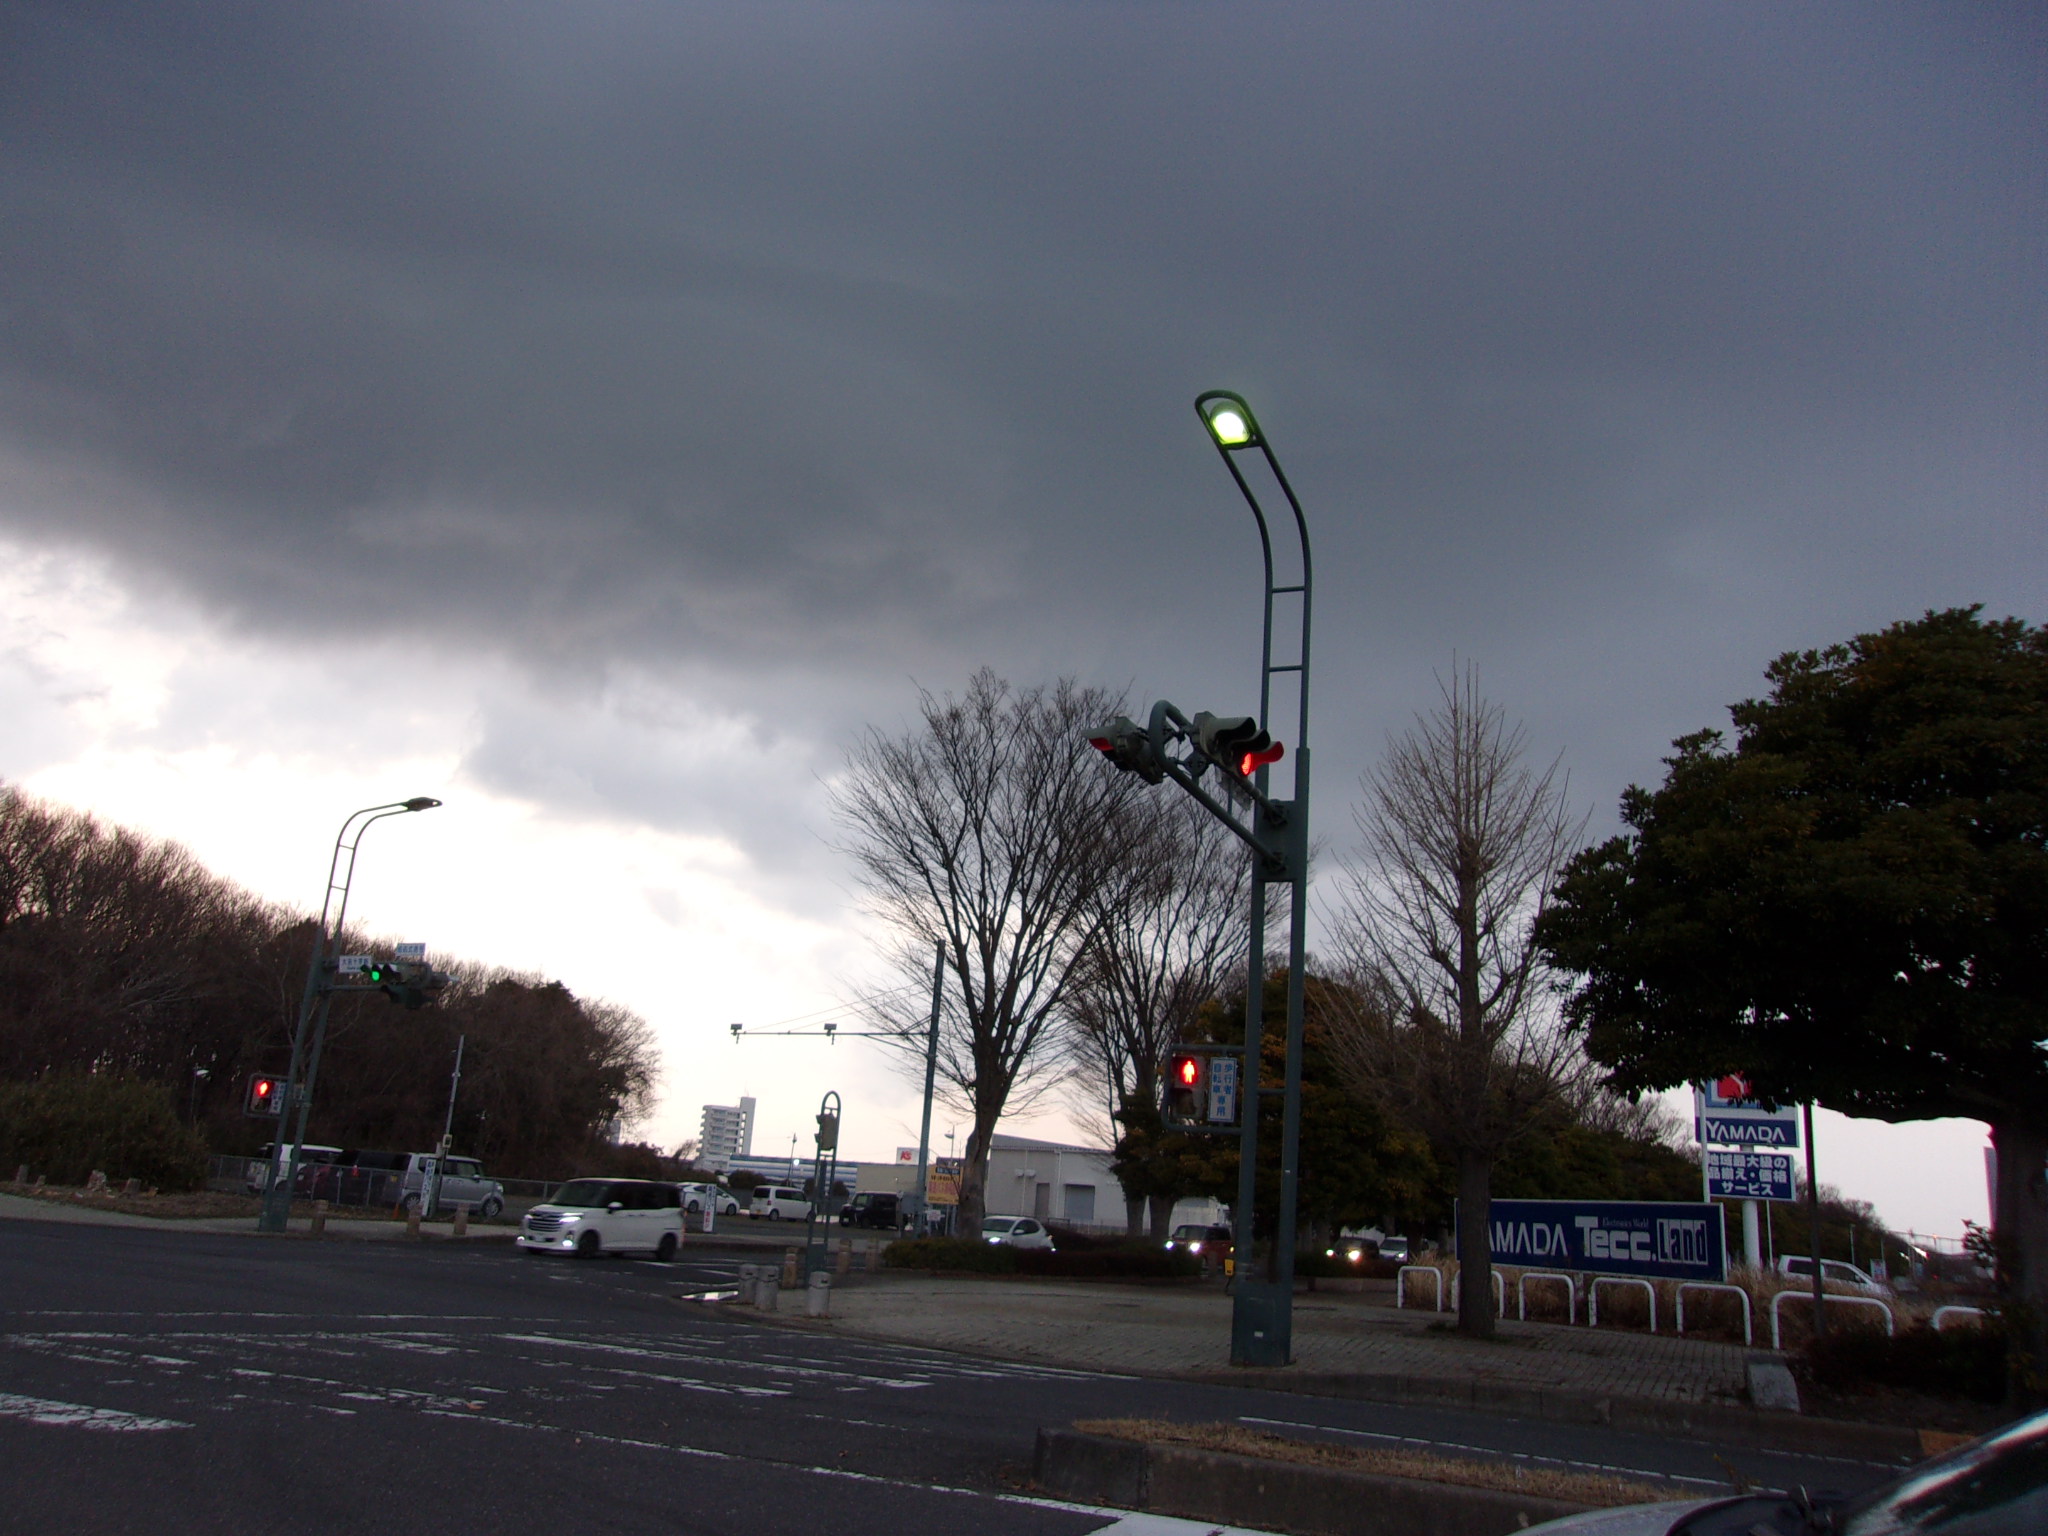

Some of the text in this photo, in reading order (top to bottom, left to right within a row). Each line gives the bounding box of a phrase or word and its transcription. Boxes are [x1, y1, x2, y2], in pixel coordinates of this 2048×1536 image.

[1707, 1120, 1785, 1142] YAMADA
[1721, 1181, 1774, 1196] サービス
[1488, 1220, 1568, 1257] MADA
